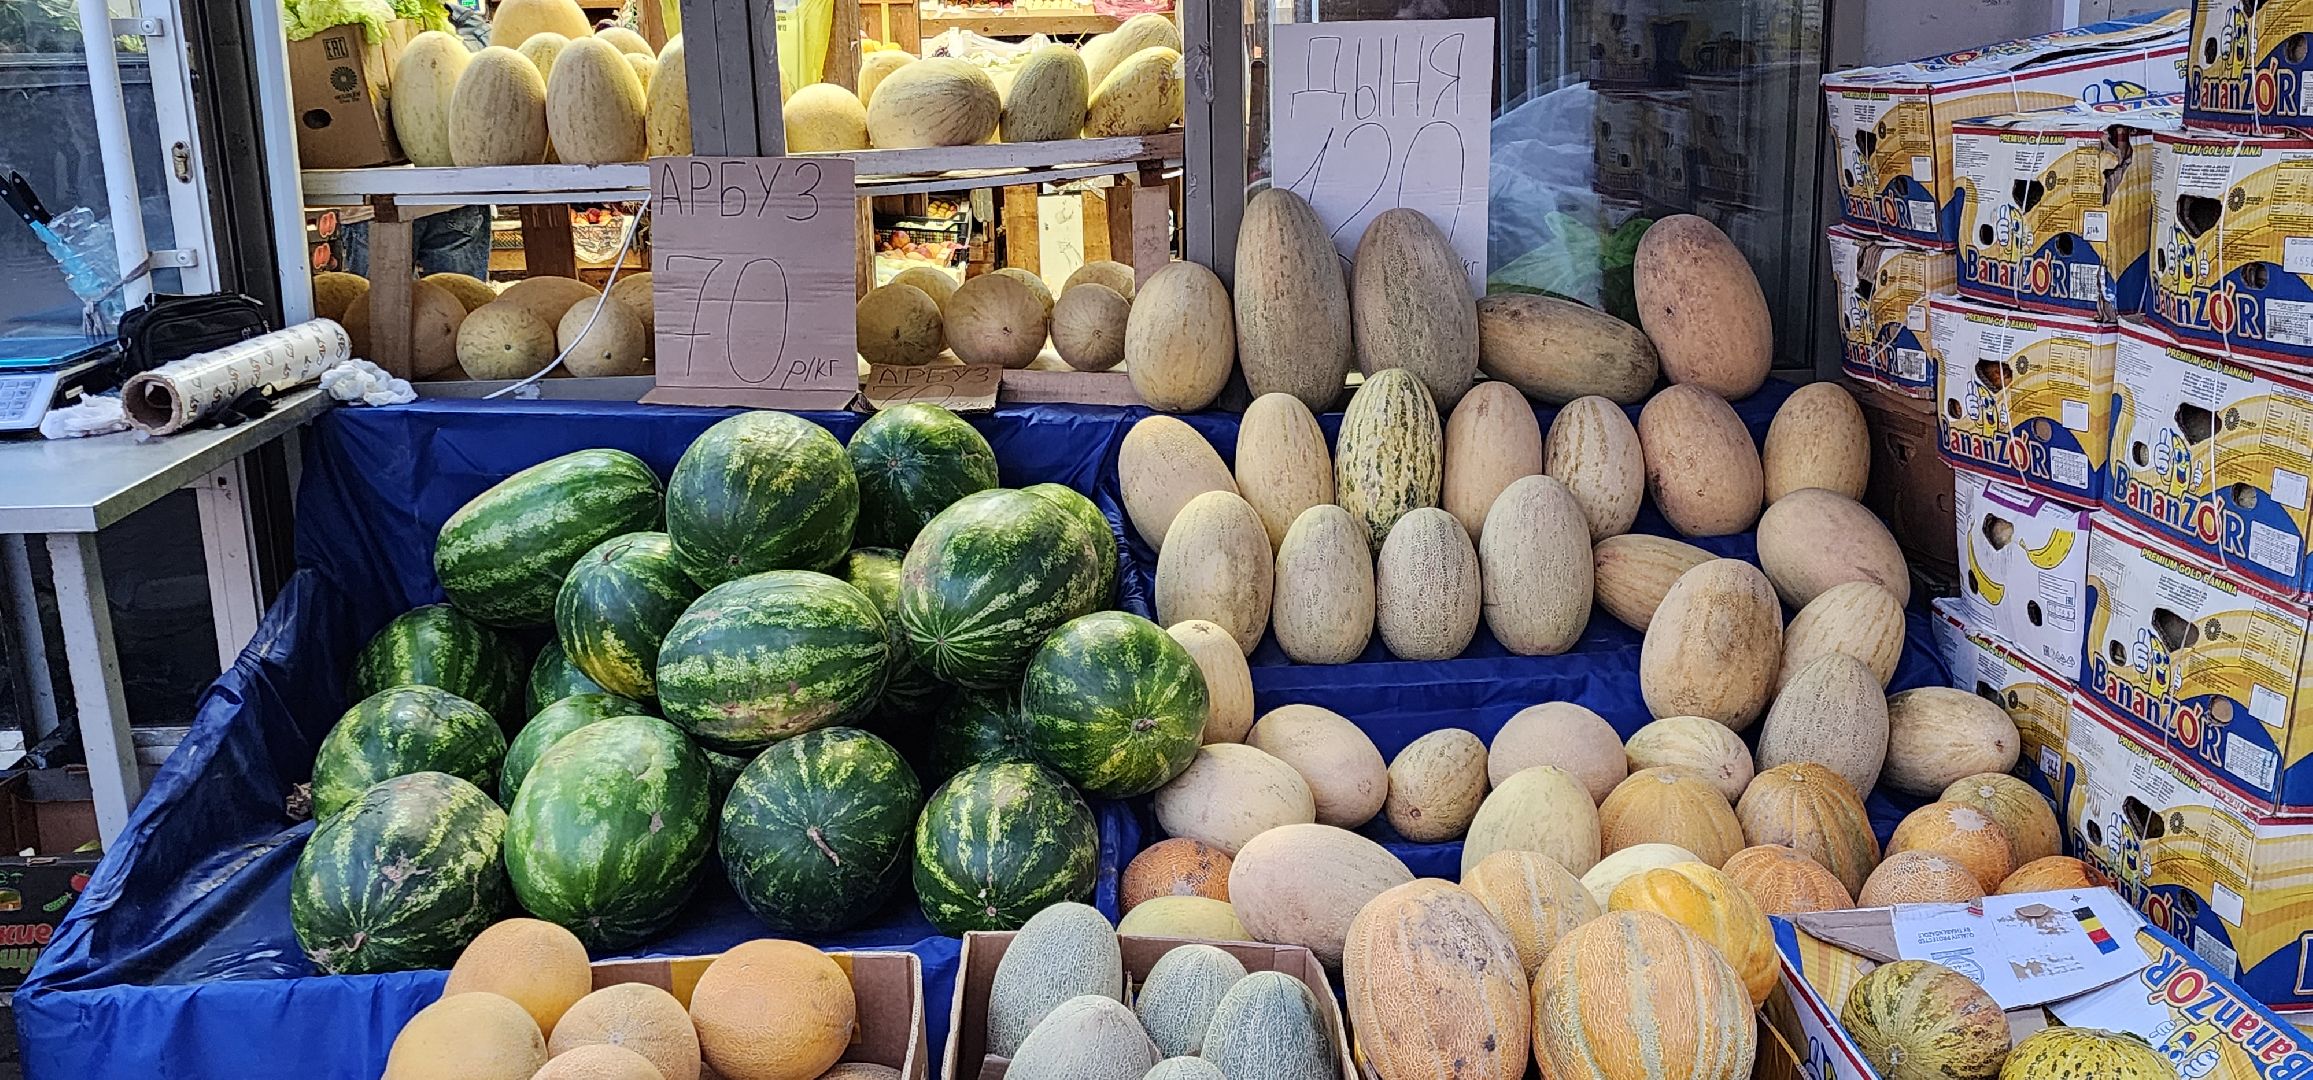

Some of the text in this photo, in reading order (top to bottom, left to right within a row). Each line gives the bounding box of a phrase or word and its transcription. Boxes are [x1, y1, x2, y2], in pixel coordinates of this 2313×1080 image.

[1290, 33, 1464, 120] ДЫНЯ
[660, 161, 823, 221] АРБУЗ
[1287, 121, 1464, 265] 120
[334, 328, 345, 358] CAST
[665, 255, 839, 390] 70 р/кг
[1994, 317, 2011, 329] GOD
[314, 336, 326, 366] CAST
[2165, 346, 2200, 367] PREMIUM
[2199, 357, 2223, 373] GOLD
[2222, 363, 2254, 383] BANANA
[878, 367, 990, 384] АРБУЗ
[2140, 547, 2179, 572] PREMIUM
[2178, 563, 2202, 582] GOLD
[2203, 569, 2238, 597] BANANA
[2003, 652, 2026, 673] ANANA
[2117, 734, 2153, 762] PREMIUM
[2171, 767, 2202, 794] BANANA
